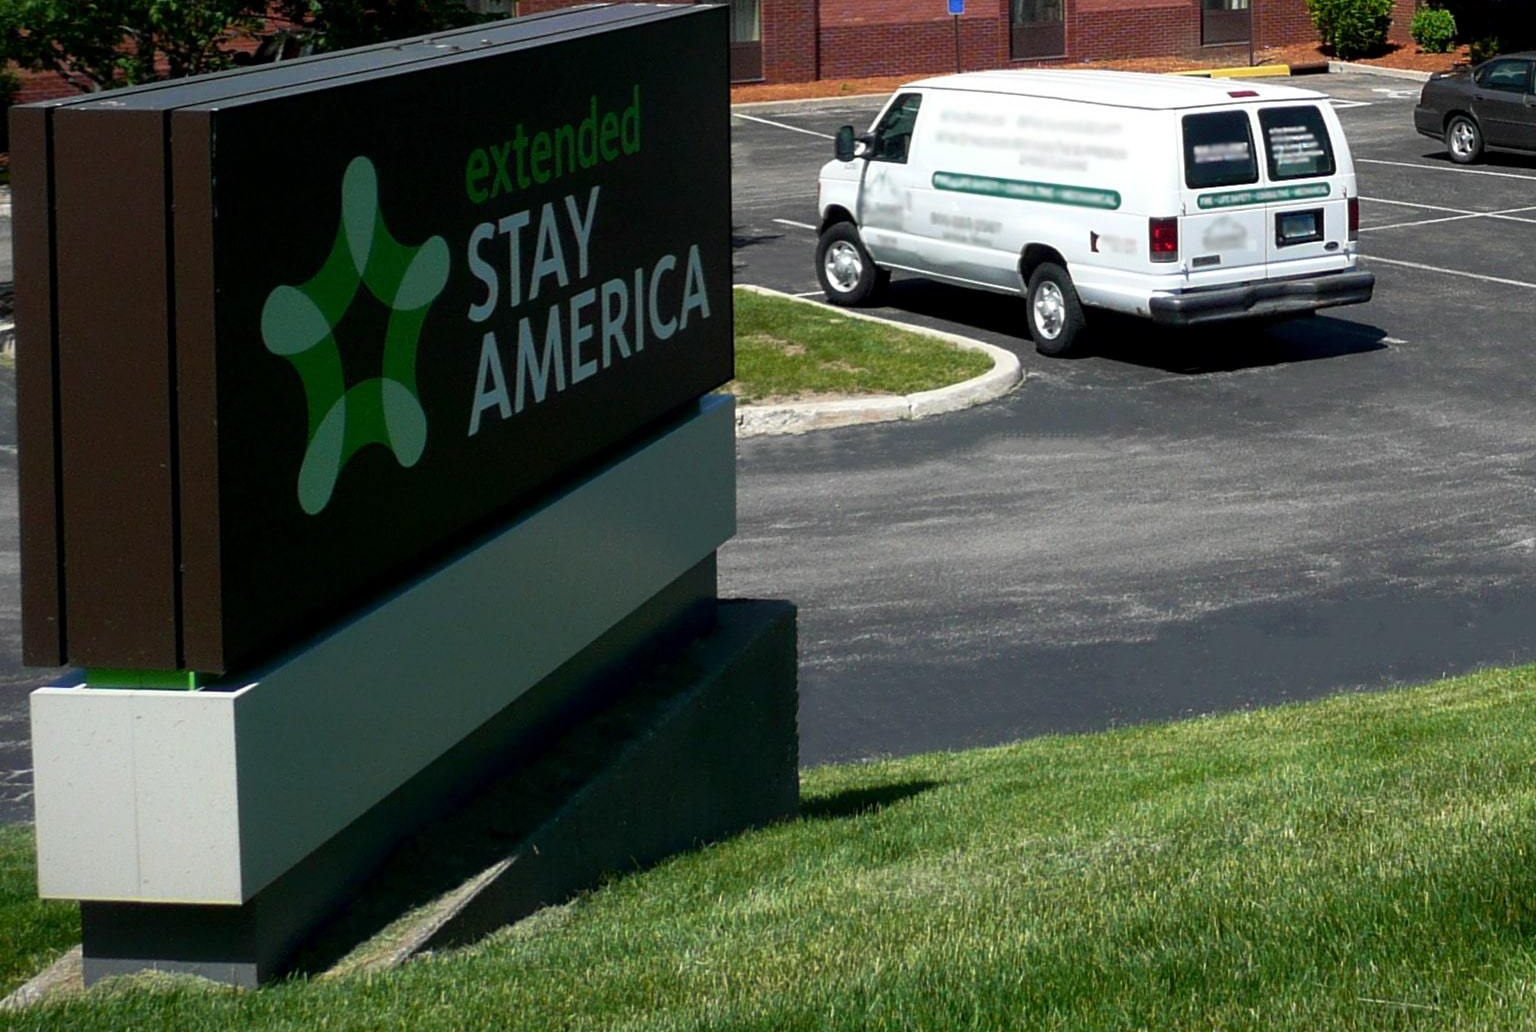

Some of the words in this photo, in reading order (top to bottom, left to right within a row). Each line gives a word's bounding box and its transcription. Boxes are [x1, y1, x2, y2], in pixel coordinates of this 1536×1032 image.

[465, 83, 641, 205] extended
[467, 185, 600, 323] STAY
[467, 243, 711, 438] AMERICA
